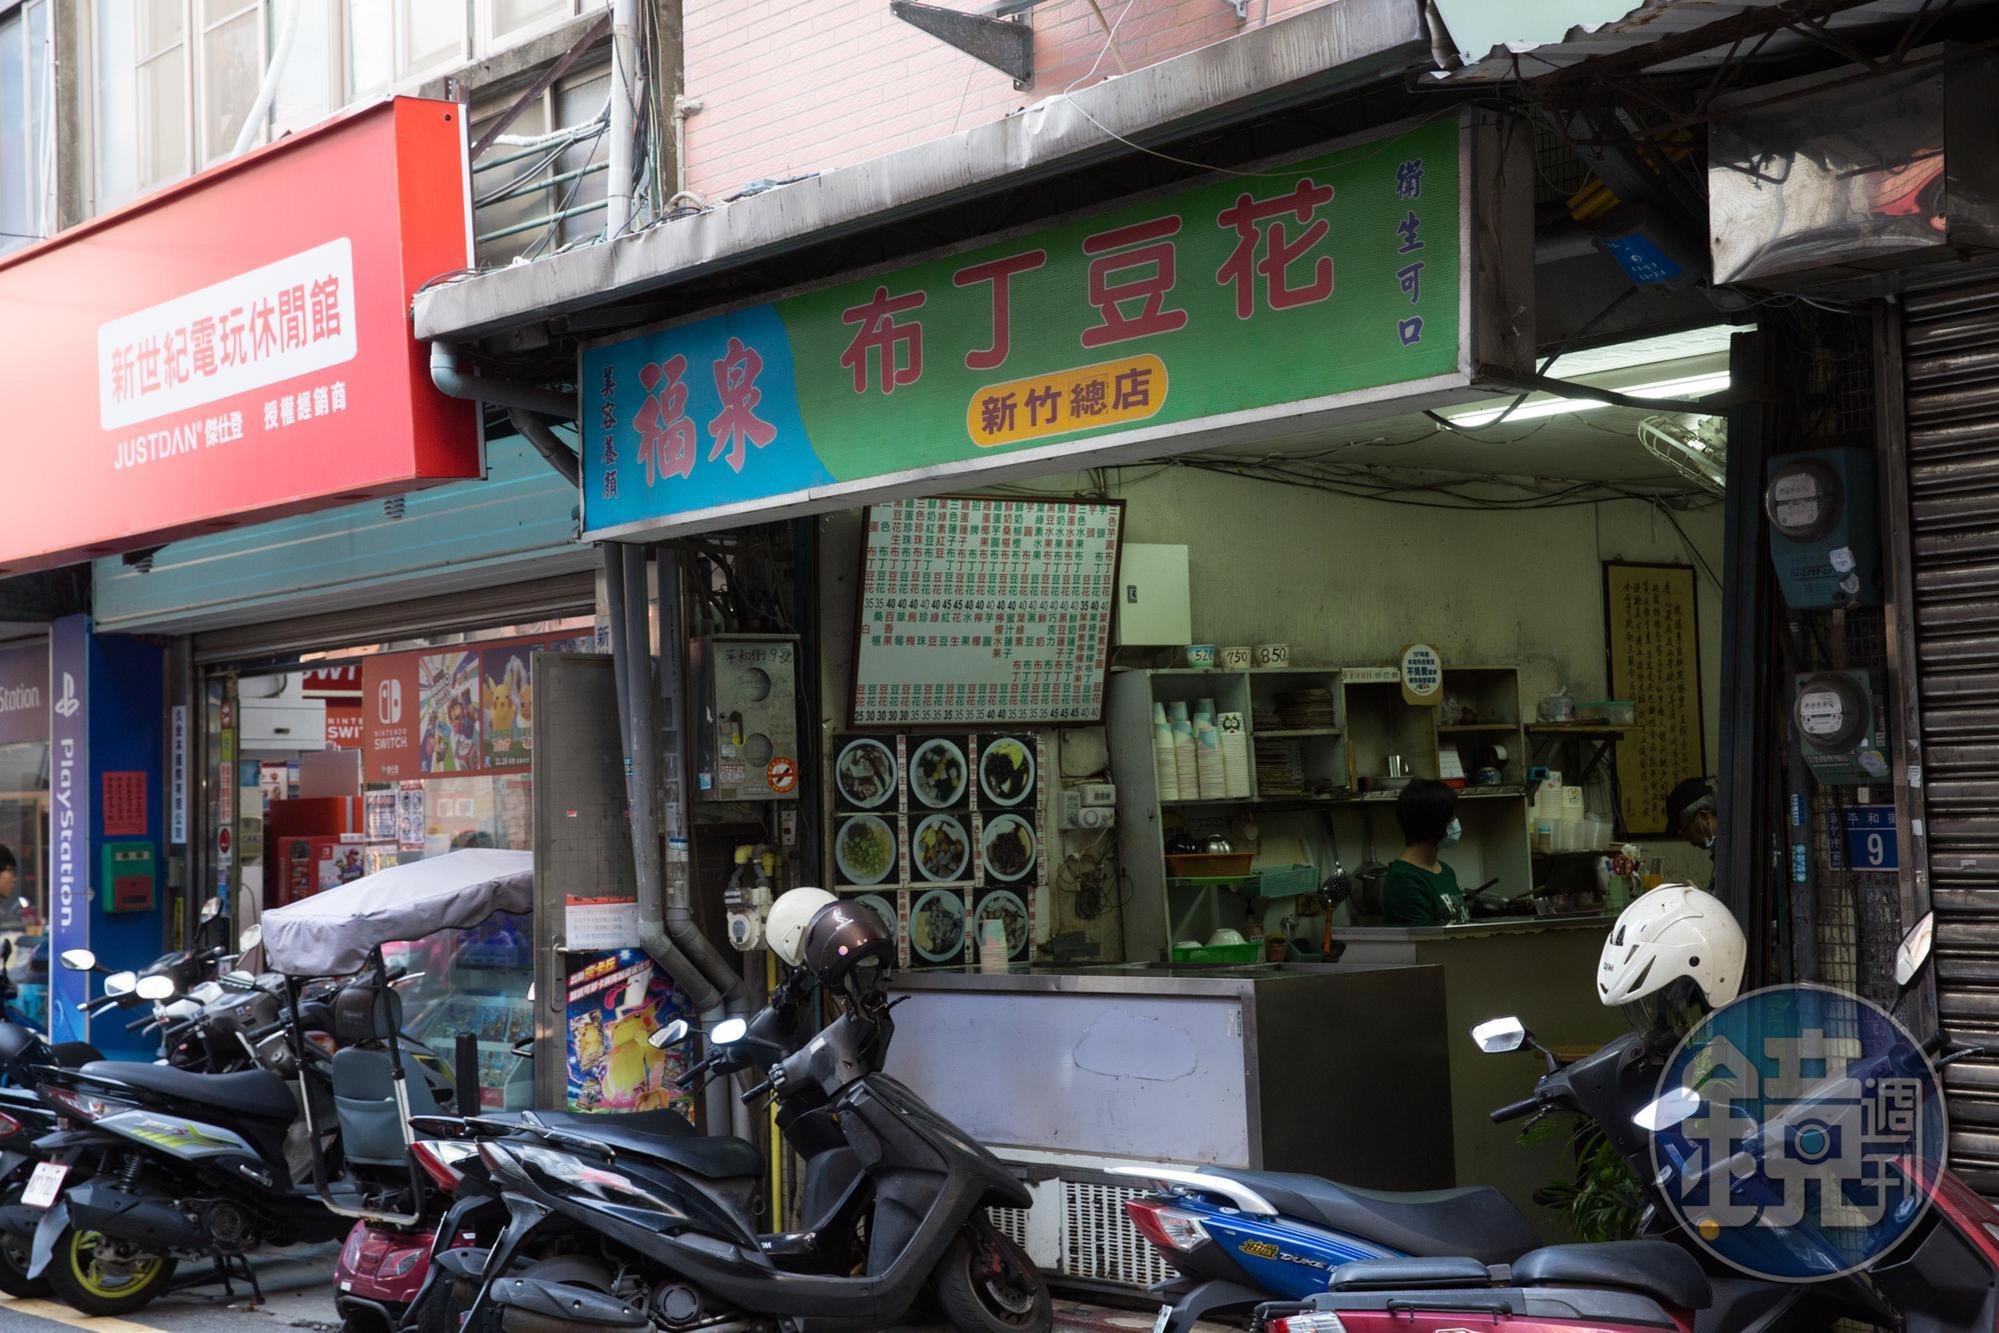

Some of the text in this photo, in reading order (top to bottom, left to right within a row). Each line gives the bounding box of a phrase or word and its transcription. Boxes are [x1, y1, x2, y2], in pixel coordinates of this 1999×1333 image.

[1395, 158, 1425, 348] 衛生可口
[839, 178, 1336, 395] 布丁豆花
[112, 273, 341, 403] 新世紀電玩休閒館
[981, 367, 1154, 436] 新竹總店
[633, 336, 778, 488] 福泉
[865, 505, 879, 593] 蛋布丁豆花
[865, 598, 1108, 610] 35 35 40 40 40 40 40 45 45 40 40 40 40 40 40 40 40 40 40 40 35 40 40
[1195, 649, 1214, 662] 520
[1227, 650, 1248, 663] 750
[1260, 646, 1287, 663] 850
[855, 708, 1099, 721] 25 30 30 30 30 35 35 35 35 35 35 35 40 40 35 35 35 35 45 45 45 40 40
[328, 725, 363, 739] SWI
[374, 727, 407, 736] NINTENDO
[374, 736, 408, 750] SWITCH
[56, 738, 75, 926] PlayStation
[1867, 832, 1884, 866] 9
[1280, 1252, 1328, 1269] DUKE
